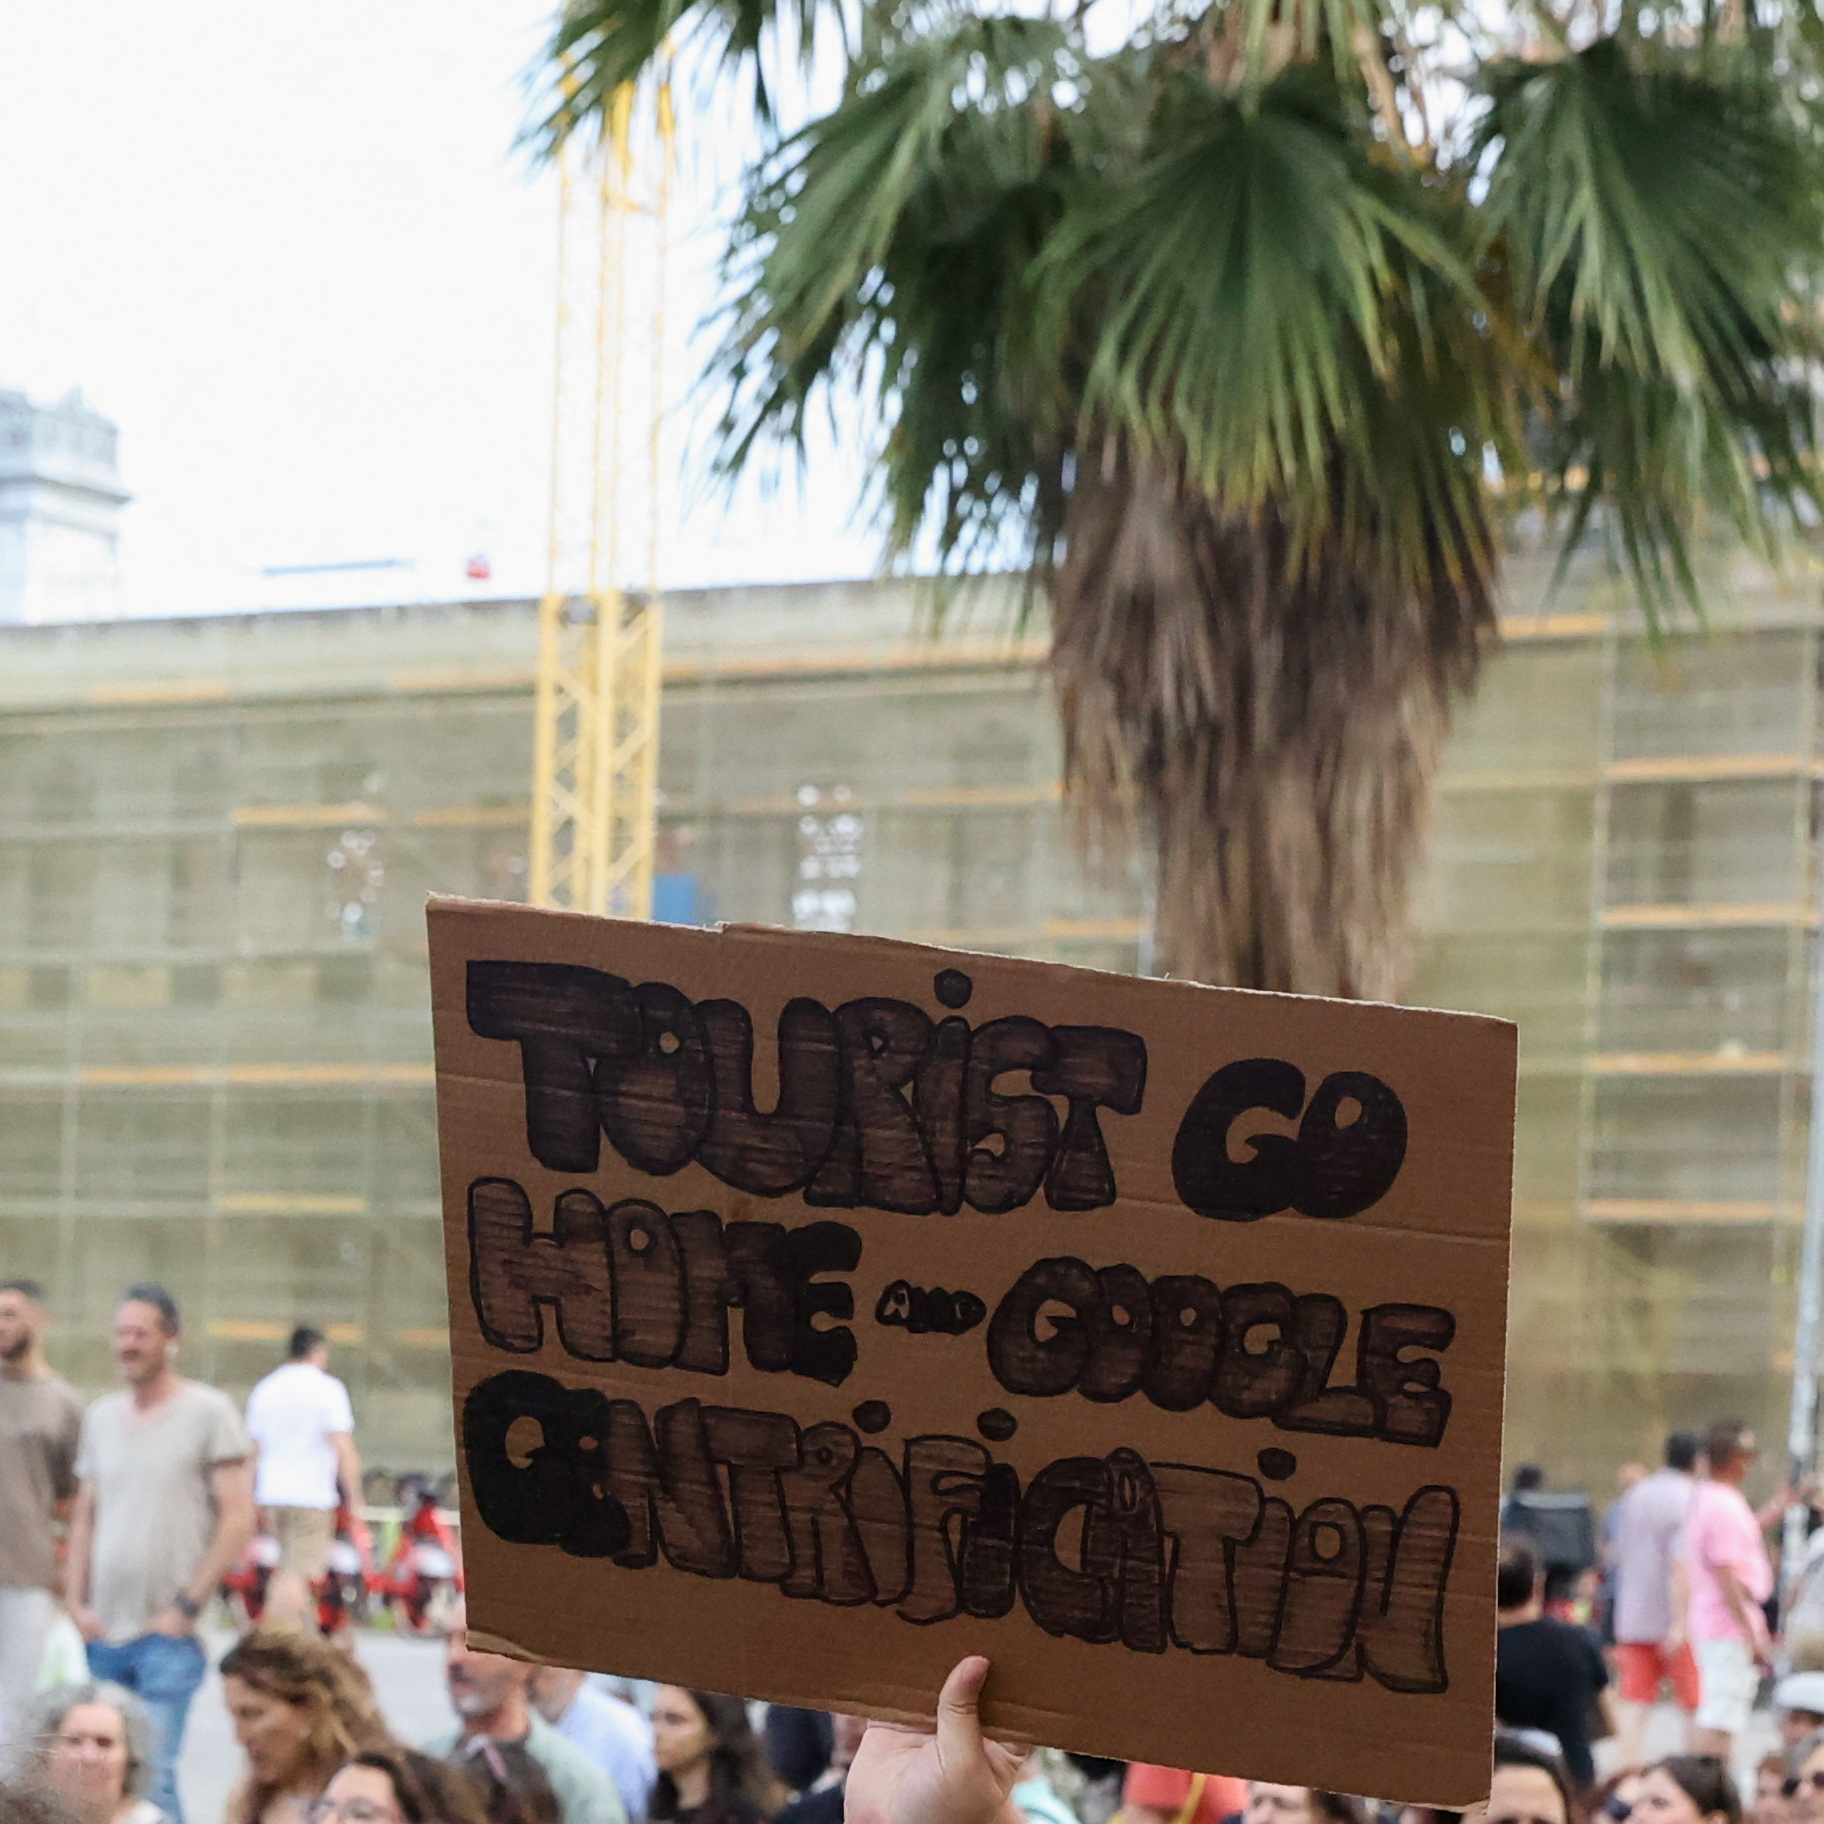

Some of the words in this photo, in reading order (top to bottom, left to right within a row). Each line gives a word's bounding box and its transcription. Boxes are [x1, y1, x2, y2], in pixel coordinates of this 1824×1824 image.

[1172, 1057, 1407, 1222] GO
[467, 1176, 862, 1388] HOME
[875, 1278, 987, 1337] AND
[986, 1255, 1455, 1448] GOOGLE
